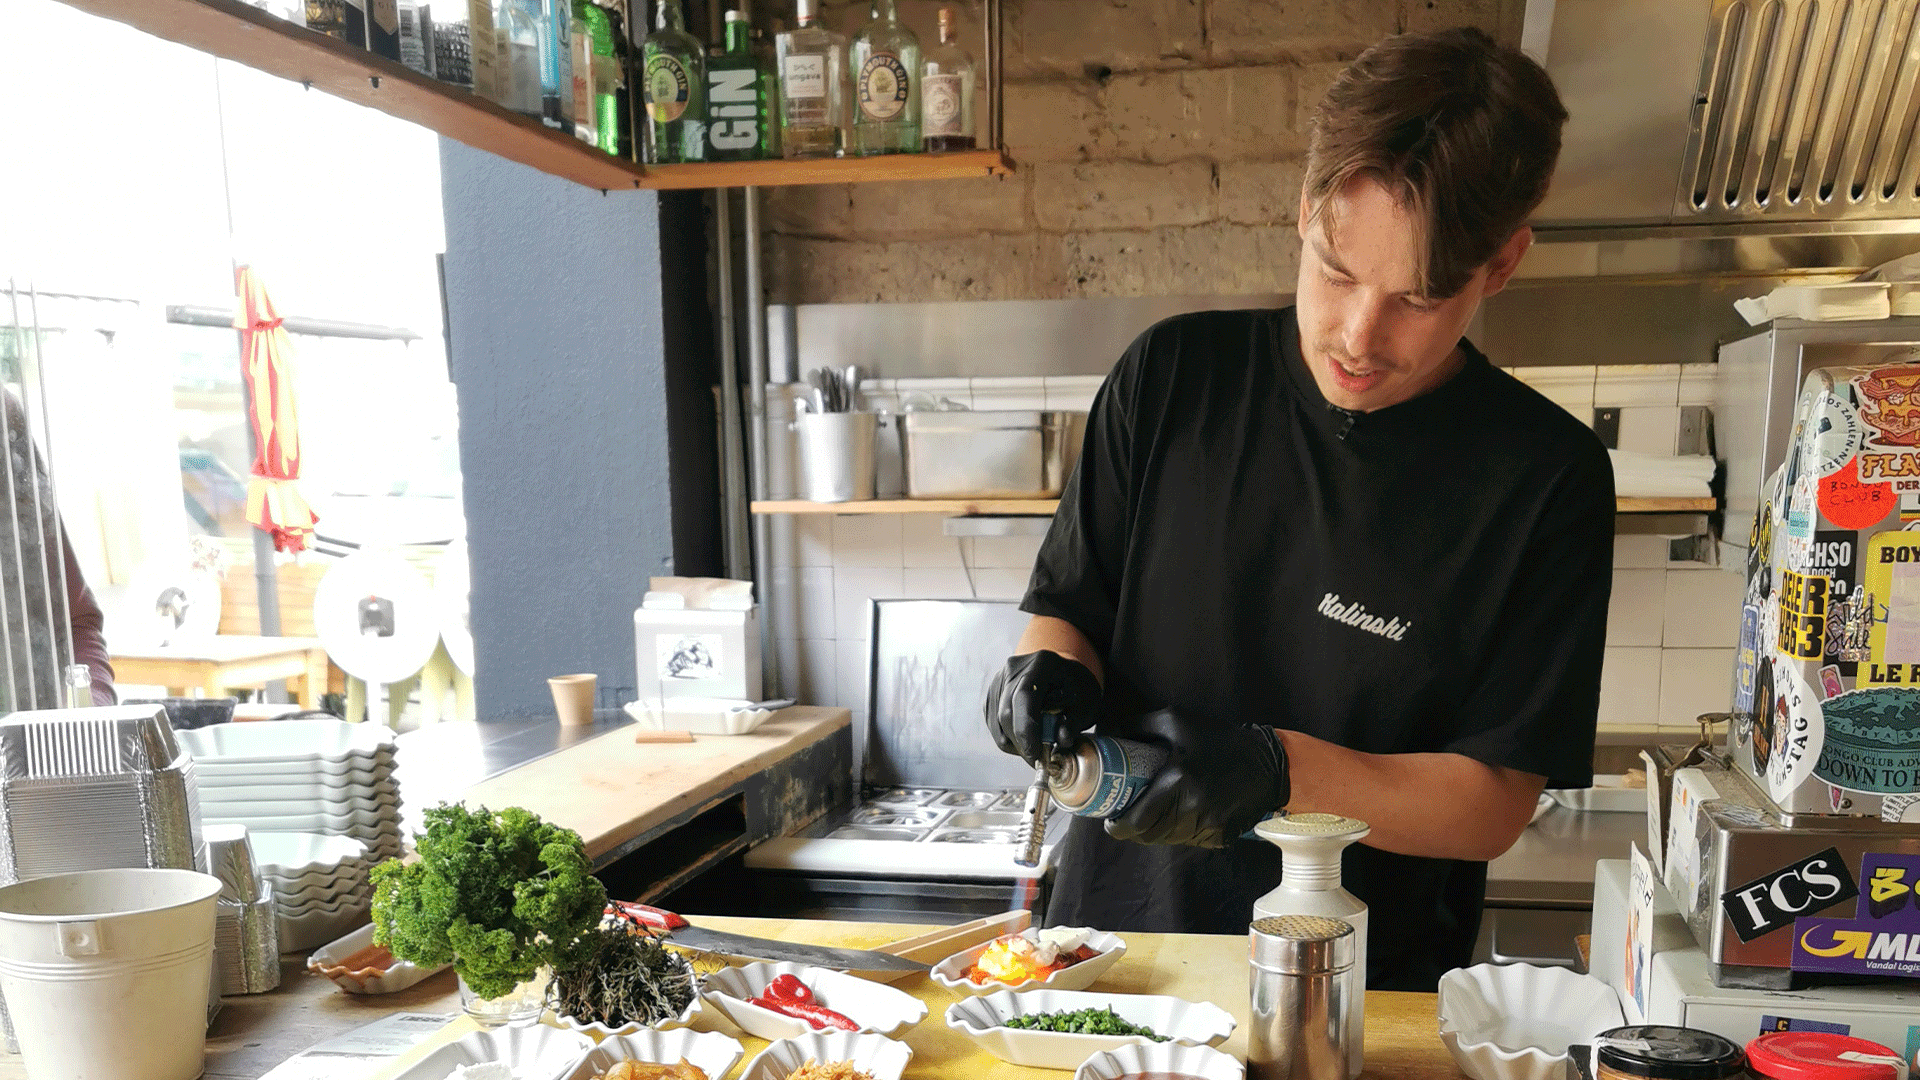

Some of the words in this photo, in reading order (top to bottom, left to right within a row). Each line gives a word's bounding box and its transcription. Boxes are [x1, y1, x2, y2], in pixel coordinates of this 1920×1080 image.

[860, 56, 899, 91] PLYMOUTH
[895, 70, 907, 89] GIN
[1841, 407, 1856, 448] ZAHLEN
[1318, 592, 1412, 641] Kalinski
[1819, 753, 1877, 785] DOWN
[1882, 769, 1908, 788] TO
[1823, 745, 1859, 762] ONGO
[1862, 756, 1894, 767] CLUB
[1735, 859, 1841, 930] FCS
[1866, 961, 1898, 970] Vandal
